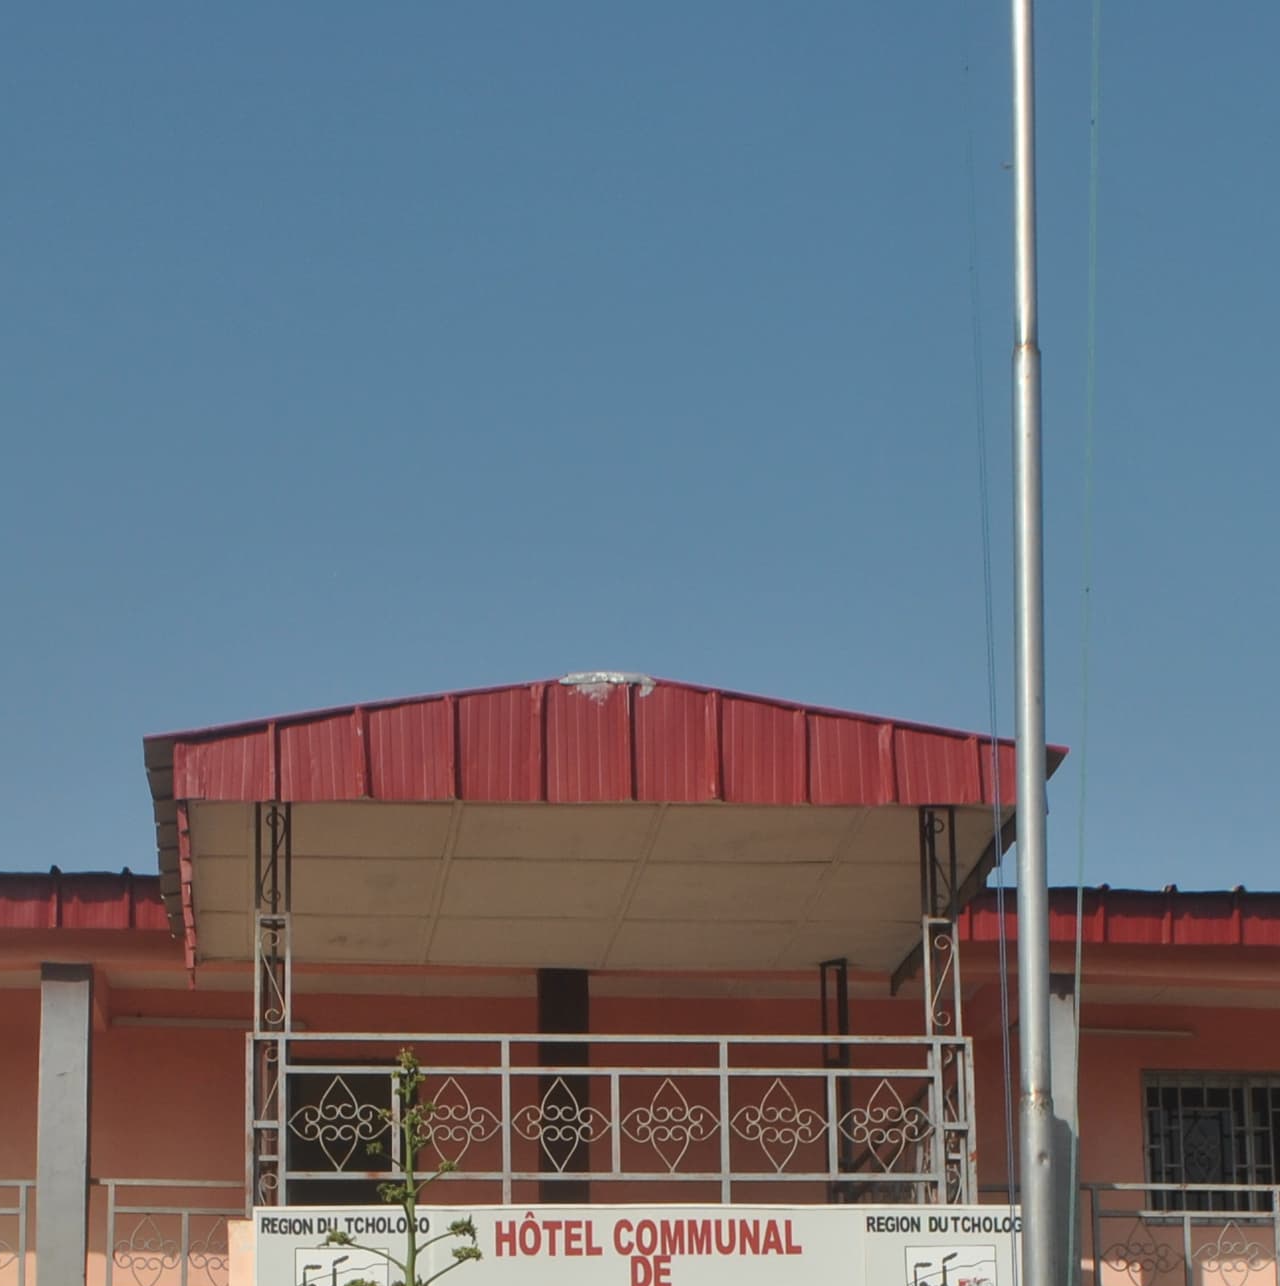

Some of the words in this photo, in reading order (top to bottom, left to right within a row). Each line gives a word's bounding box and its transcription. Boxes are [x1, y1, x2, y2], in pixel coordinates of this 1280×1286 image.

[261, 1217, 313, 1235] REGION
[317, 1217, 338, 1234] DU
[866, 1216, 921, 1233] REGION
[928, 1216, 949, 1233] DU
[951, 1216, 1023, 1233] TCHOLOG
[495, 1211, 603, 1257] HÔTEL
[613, 1218, 803, 1256] COMMUNAL
